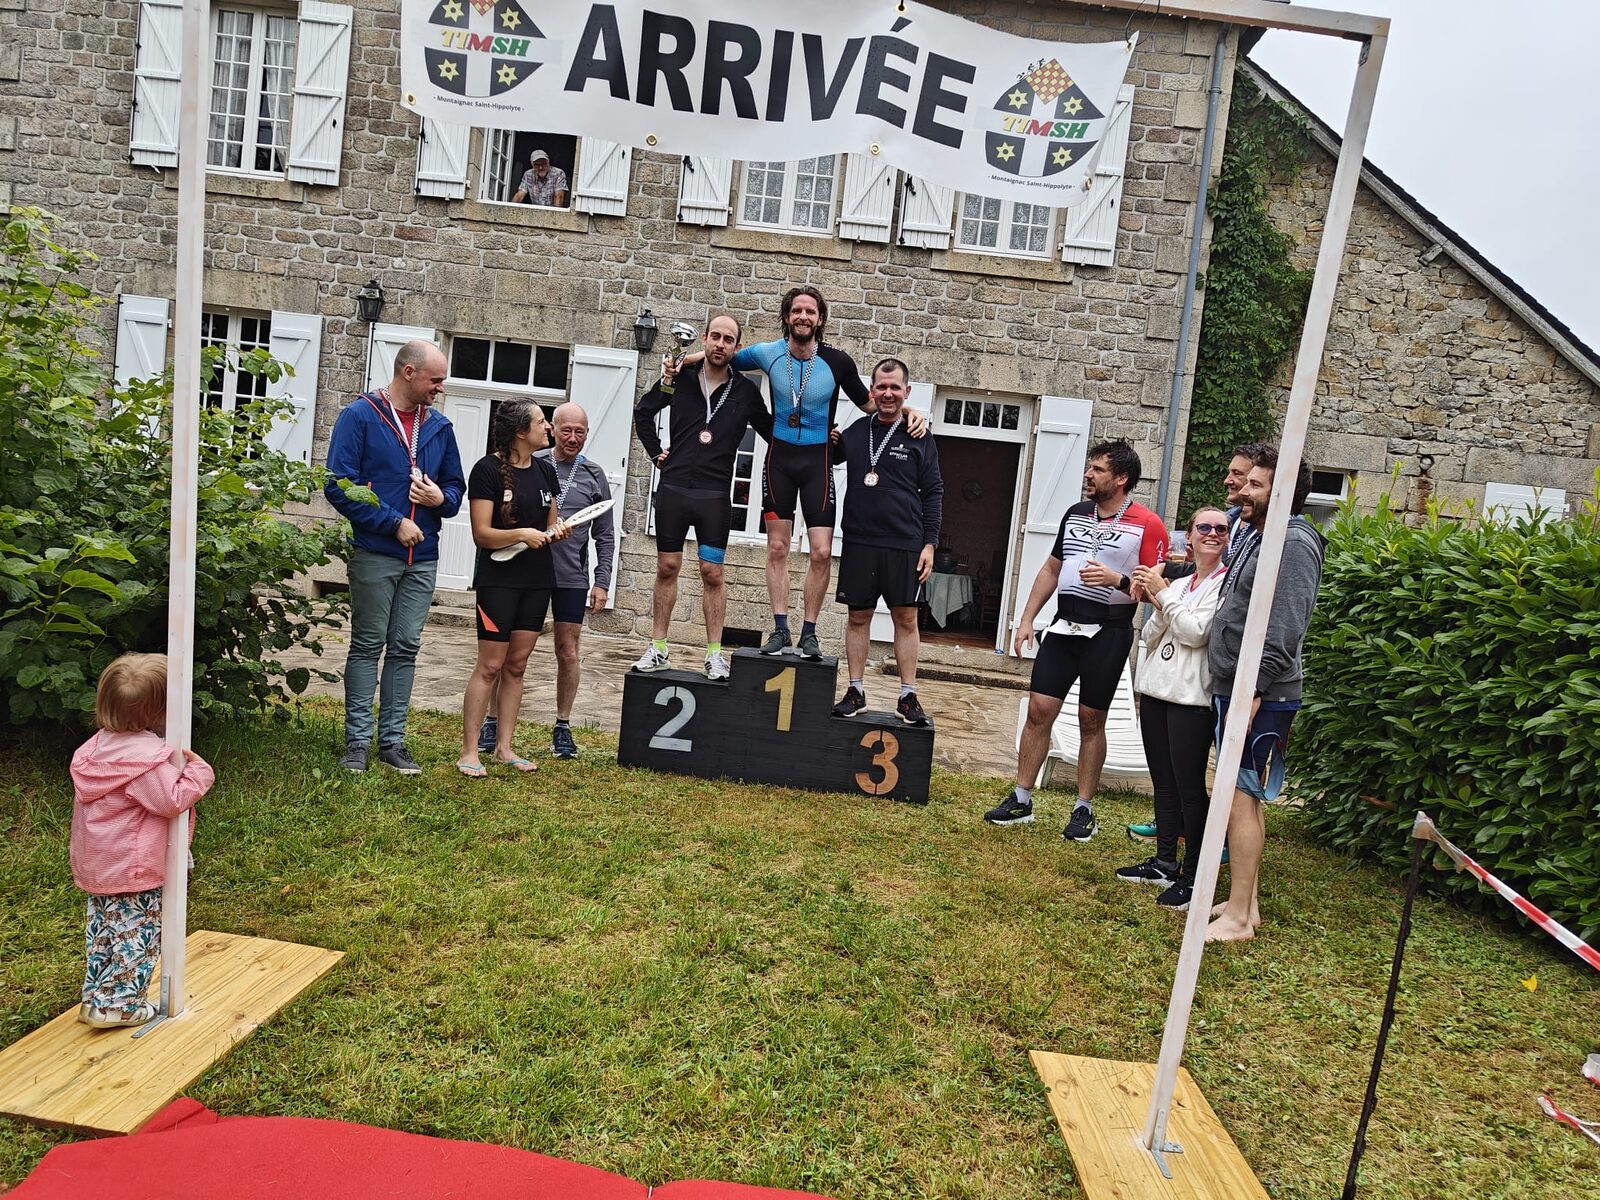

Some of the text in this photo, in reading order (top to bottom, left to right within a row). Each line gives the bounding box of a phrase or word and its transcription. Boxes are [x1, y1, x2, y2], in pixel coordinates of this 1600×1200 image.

[441, 28, 531, 57] TIMSH
[564, 3, 977, 149] ARRIVÉE
[437, 95, 521, 112] Montaignac Saint-Hippolyte
[1003, 115, 1090, 139] TIMSH
[991, 174, 1072, 191] Montaignac Saint-Hippolyte
[649, 686, 696, 752] 2
[765, 666, 797, 731] 1
[855, 729, 899, 795] 3
